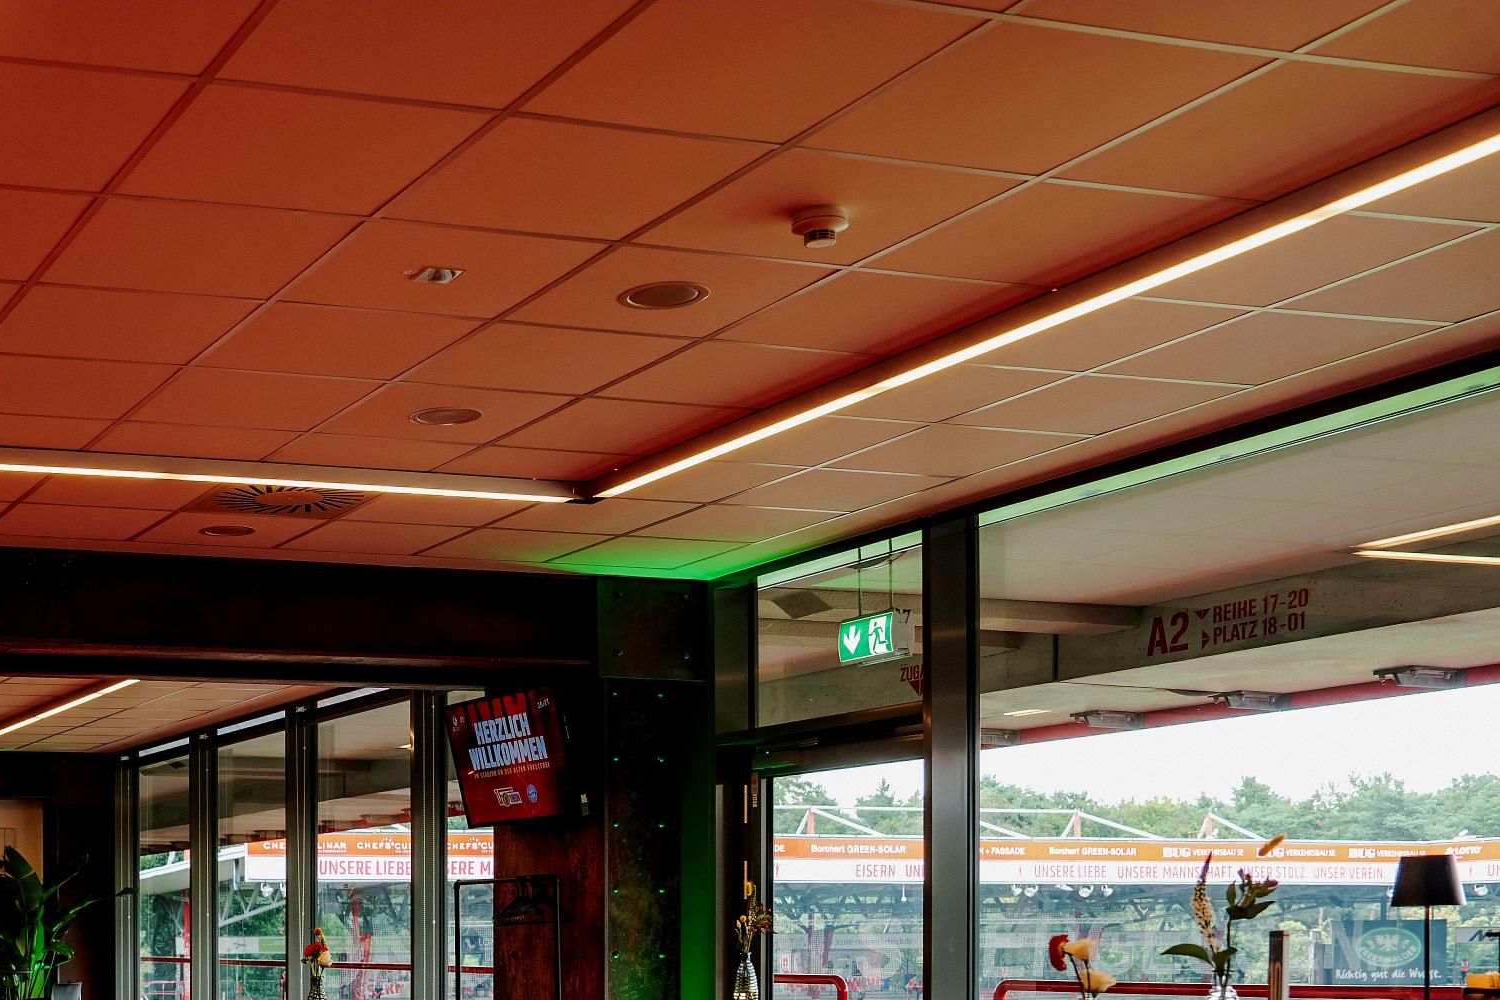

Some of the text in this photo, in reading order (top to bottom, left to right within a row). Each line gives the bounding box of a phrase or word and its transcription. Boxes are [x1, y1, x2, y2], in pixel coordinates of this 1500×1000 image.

[1213, 587, 1309, 623] REIHE 17-20
[1147, 611, 1190, 657] A2
[1213, 611, 1305, 645] PLATZ 18-01
[474, 712, 531, 745] HERZLICH
[468, 736, 548, 771] WILLKOMMEN
[810, 845, 906, 854] Borchert GREEN-SOLAR
[991, 847, 1025, 856] FASSADE
[1049, 846, 1137, 856] Borchert GREEN-SOLAR
[320, 861, 411, 876] UNSERE LIEBE
[855, 864, 896, 878] EISERN
[1034, 865, 1107, 878] UNSERE LIEBE
[1117, 866, 1235, 879] UNSERE MANNSHAFT.
[1314, 867, 1386, 880] UNSER VEREIN.
[1335, 967, 1442, 982] Richtig gut die Wust.
